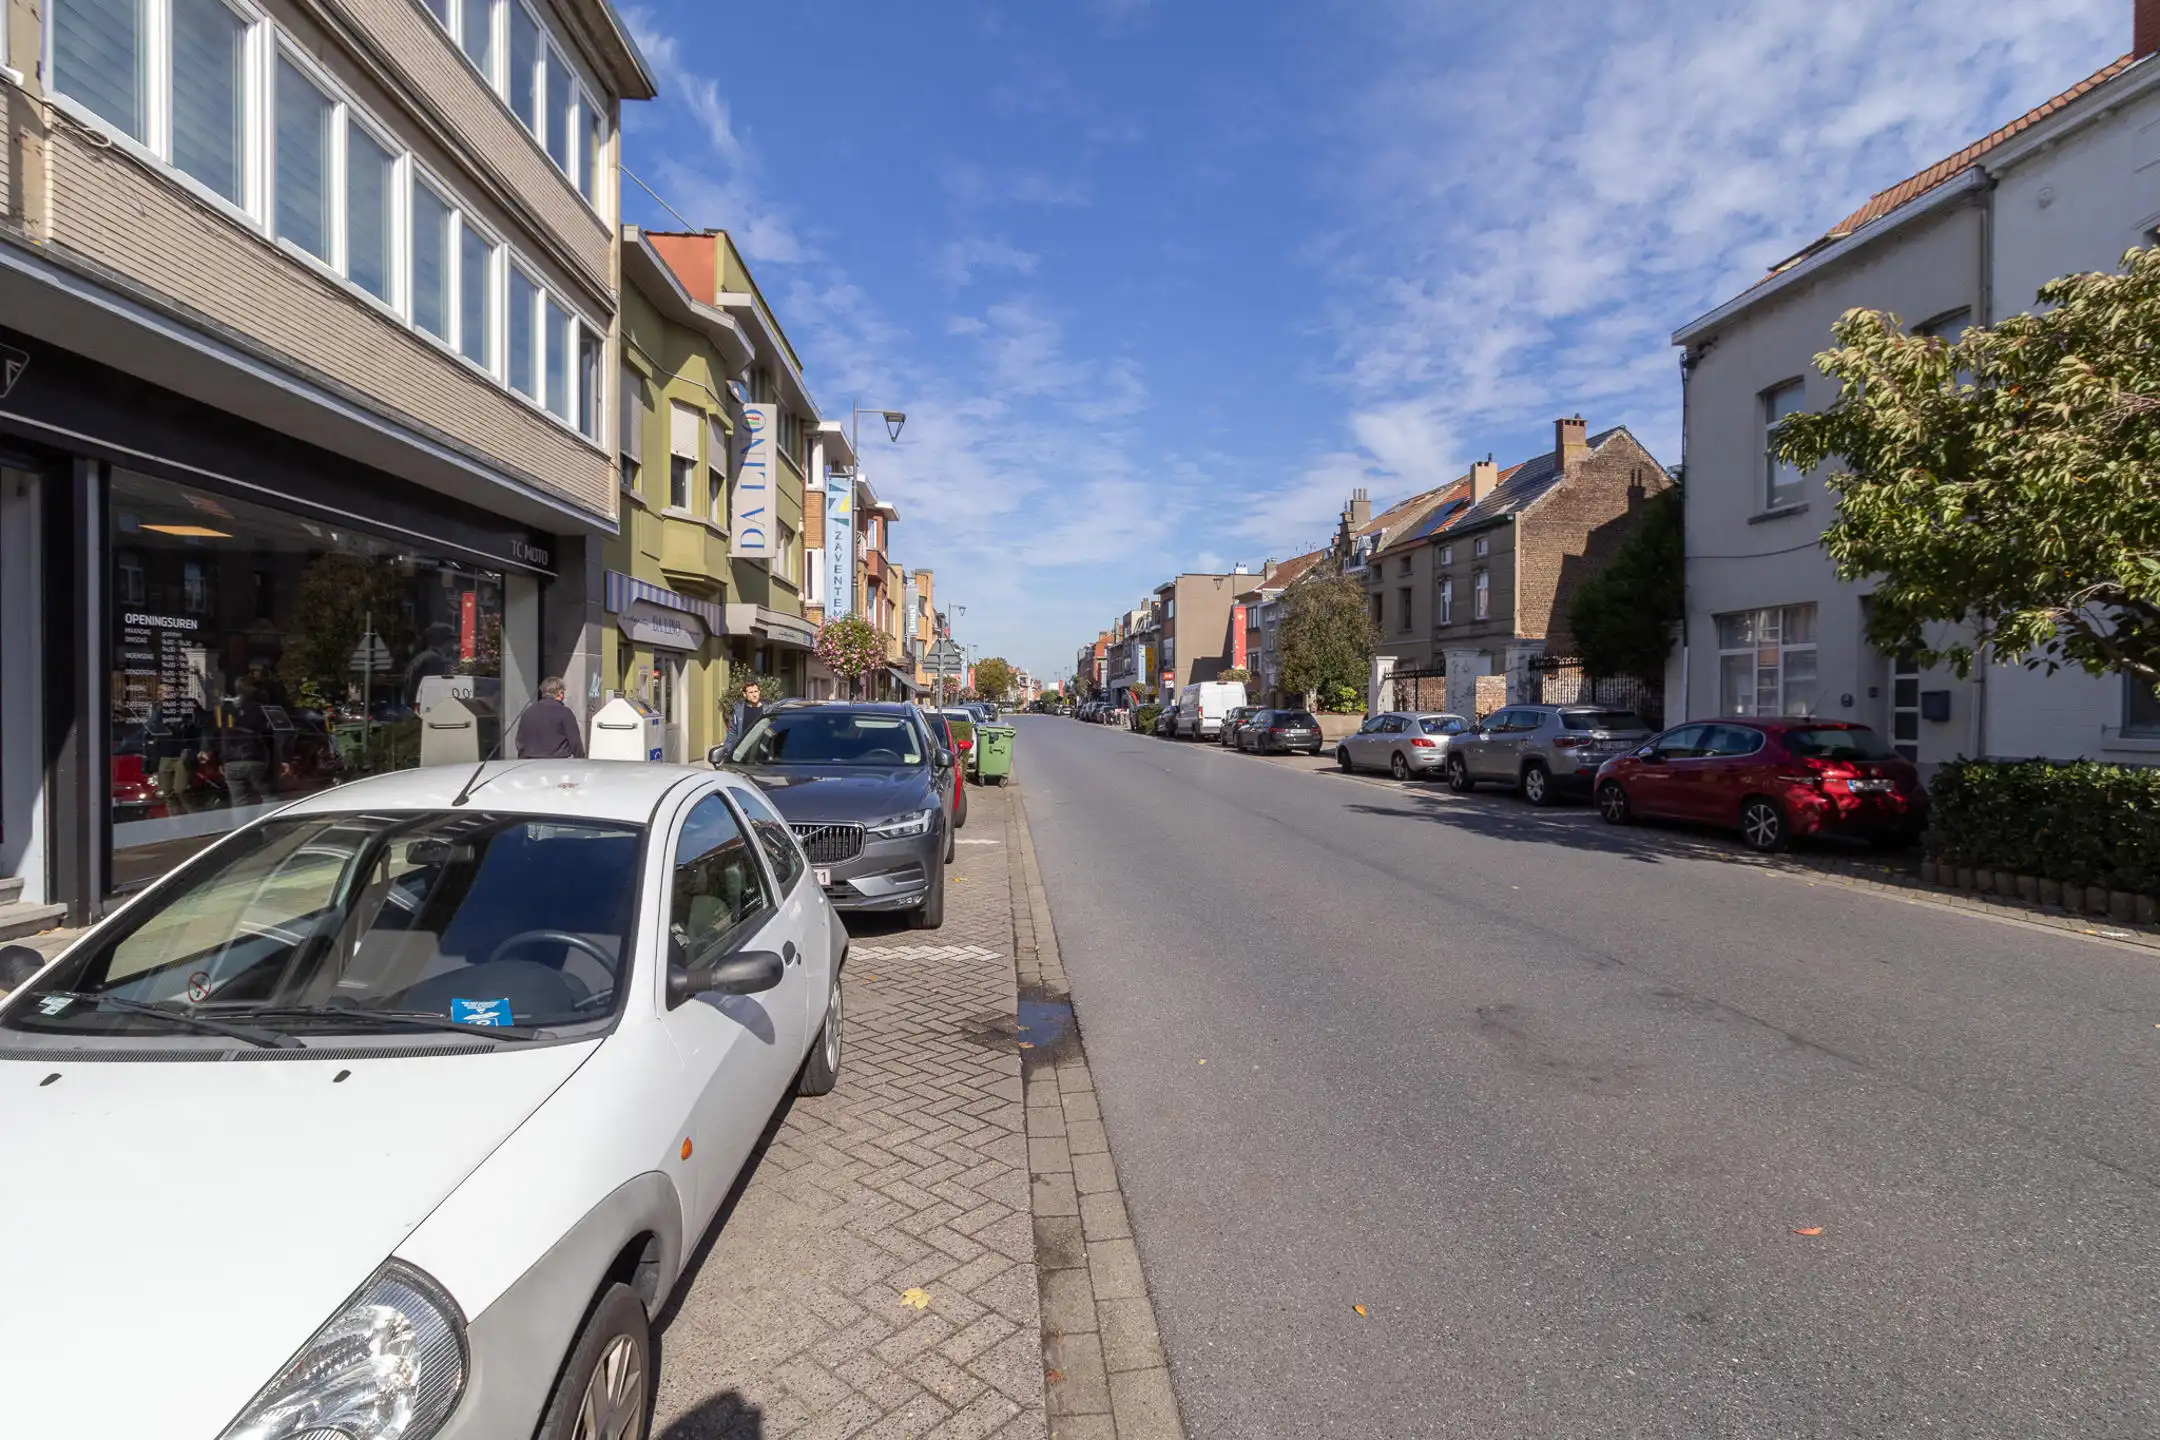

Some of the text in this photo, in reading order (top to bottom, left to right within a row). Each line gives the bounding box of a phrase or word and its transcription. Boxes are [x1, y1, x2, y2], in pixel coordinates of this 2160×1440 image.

[740, 408, 767, 553] DA LINO
[511, 539, 549, 566] TC MOTO
[124, 613, 198, 629] OPENINGSUREN
